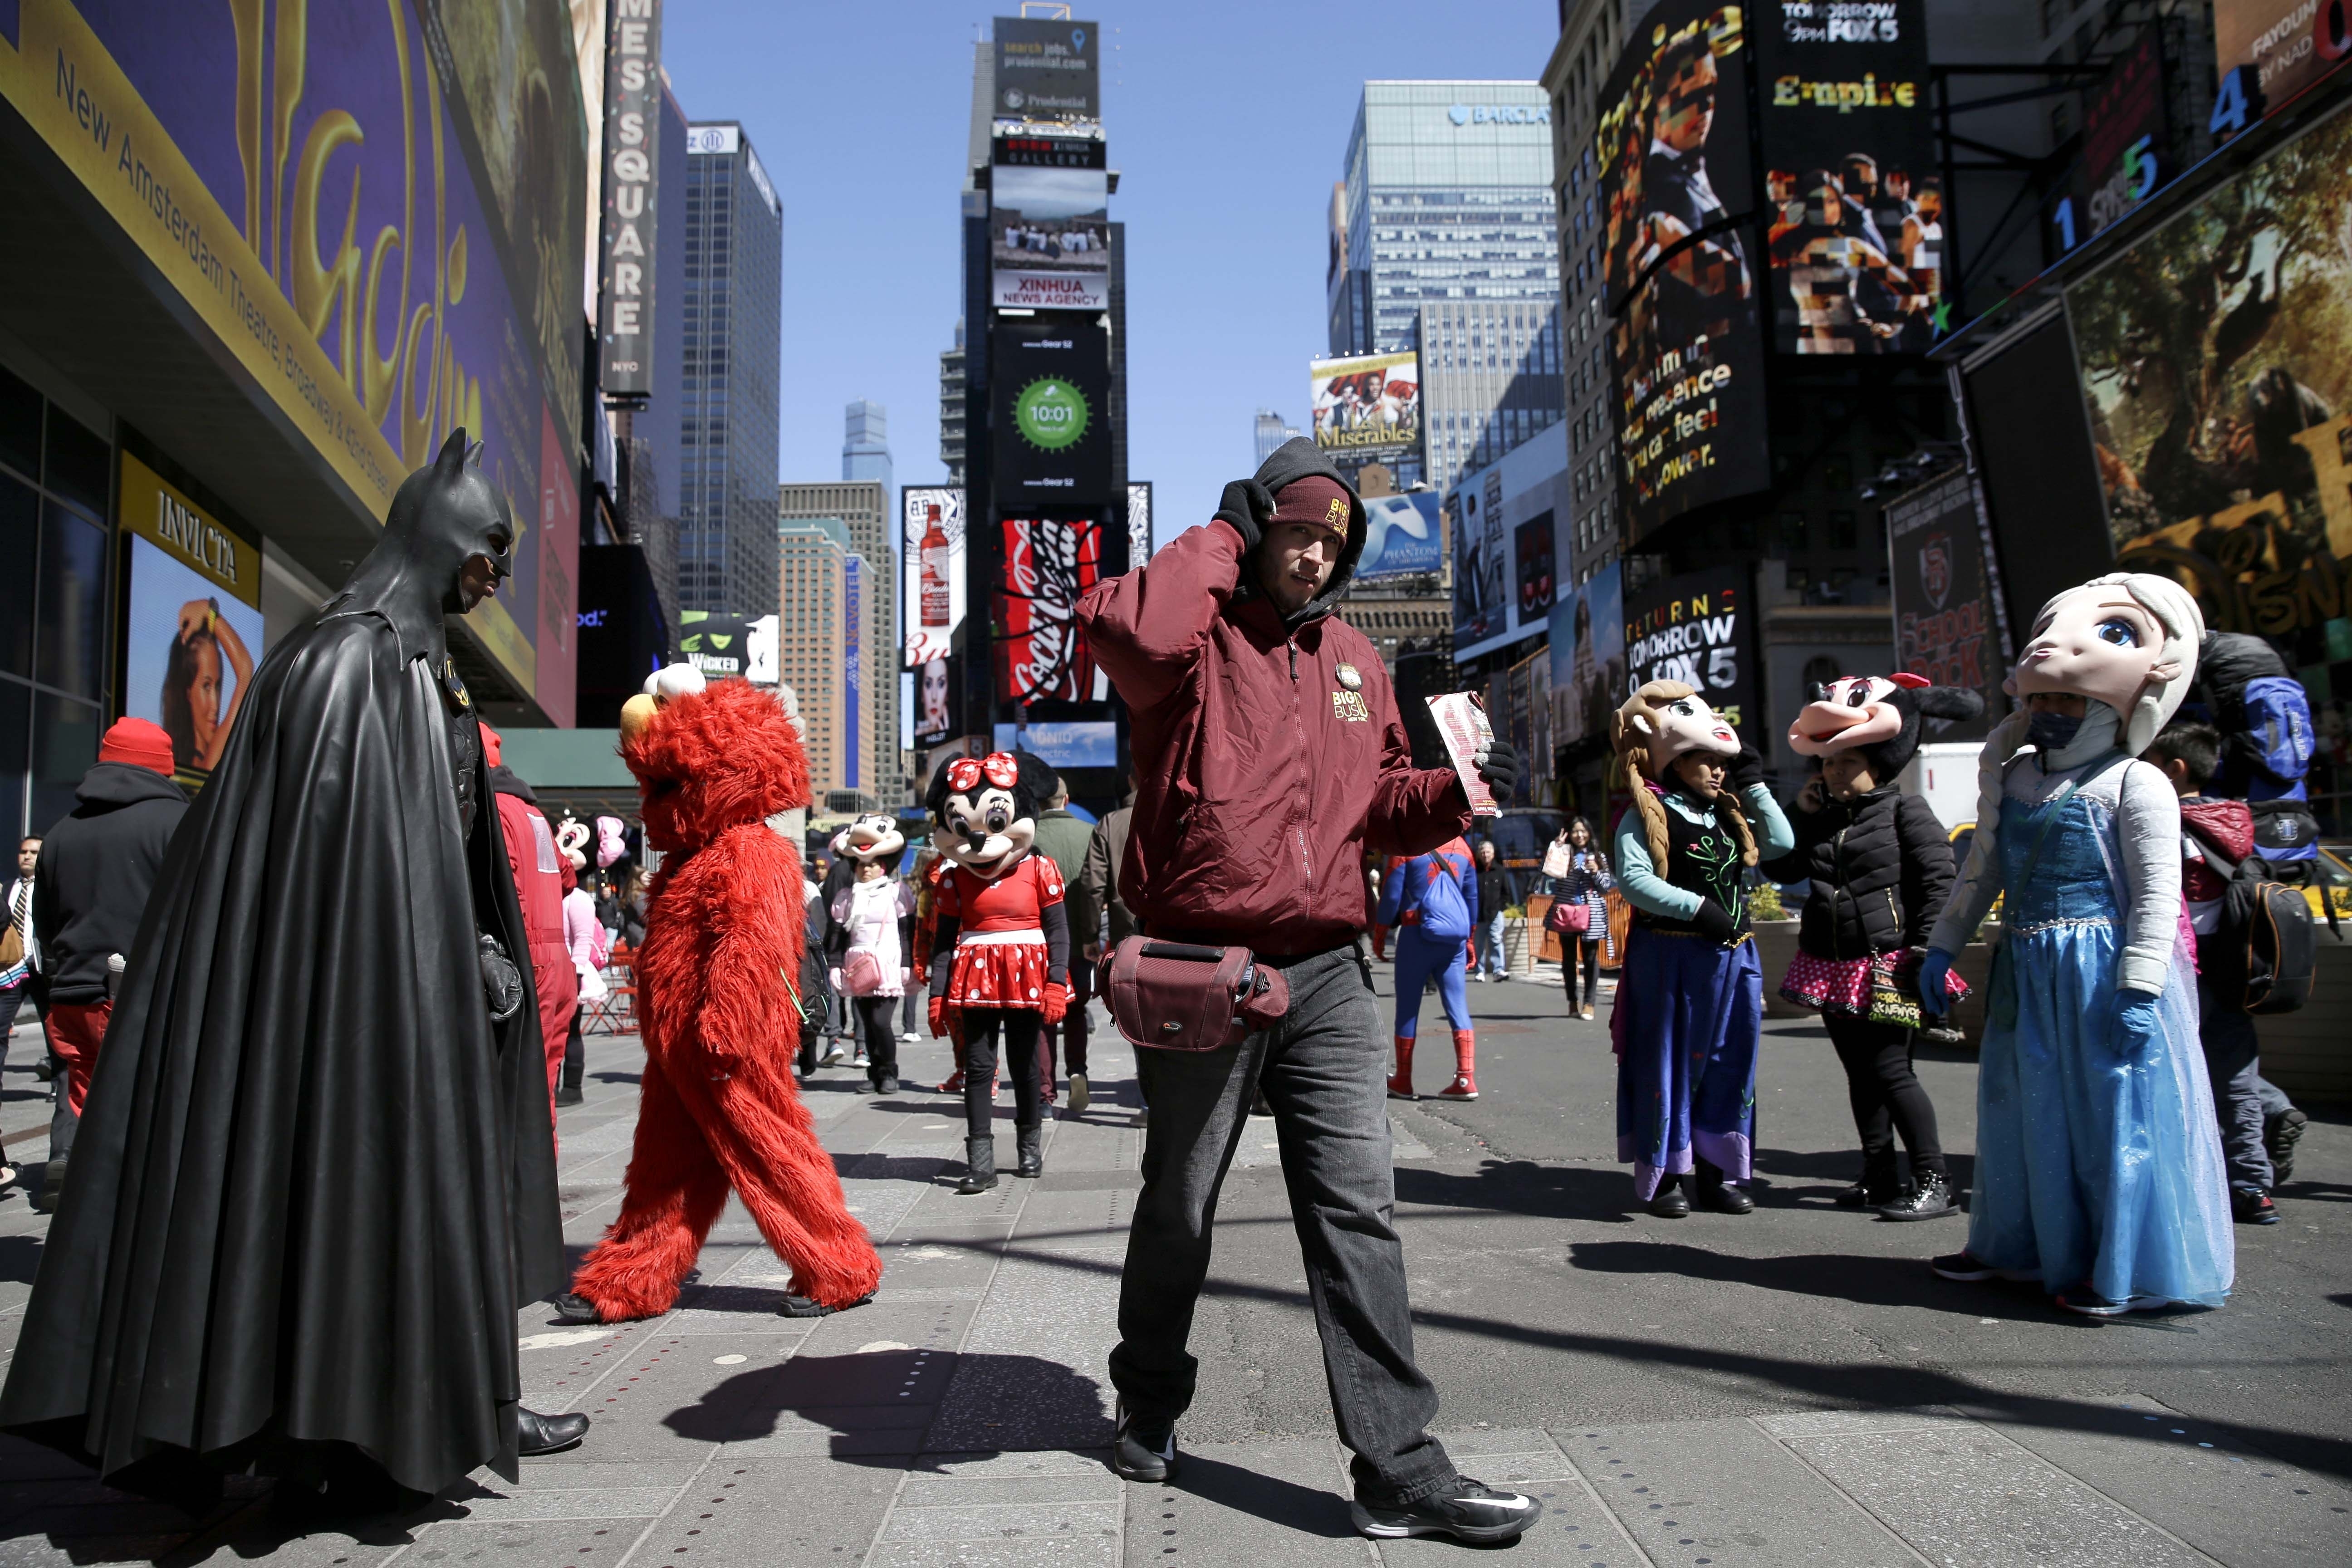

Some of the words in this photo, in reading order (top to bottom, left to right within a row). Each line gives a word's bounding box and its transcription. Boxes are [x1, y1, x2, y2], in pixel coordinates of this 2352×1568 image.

[1828, 19, 1878, 42] FOX
[1879, 19, 1900, 42] 5
[1004, 41, 1042, 54] search
[1004, 55, 1087, 70] prudential.com
[1028, 94, 1087, 108] Prudential
[1009, 151, 1090, 166] GALLERY
[612, 113, 651, 335] SQUARE
[56, 47, 110, 152] New
[118, 133, 224, 294] Amsterdam
[229, 267, 281, 368] Theatre,
[285, 342, 333, 435] Broadway
[1019, 278, 1084, 293] XINHUA
[1003, 293, 1041, 304] NEWS
[1045, 294, 1100, 305] AGENCY
[1041, 340, 1062, 348] Gear
[612, 361, 638, 373] NYC
[1030, 406, 1073, 421] 10:01
[1673, 397, 1719, 442] feel
[1351, 413, 1376, 431] Les
[1043, 478, 1063, 486] Gear
[158, 490, 237, 584] INVICTA
[846, 565, 859, 646] NOVOTEL
[1332, 691, 1355, 706] BIG
[1334, 704, 1360, 718] BUS
[1032, 731, 1073, 745] IONIQ
